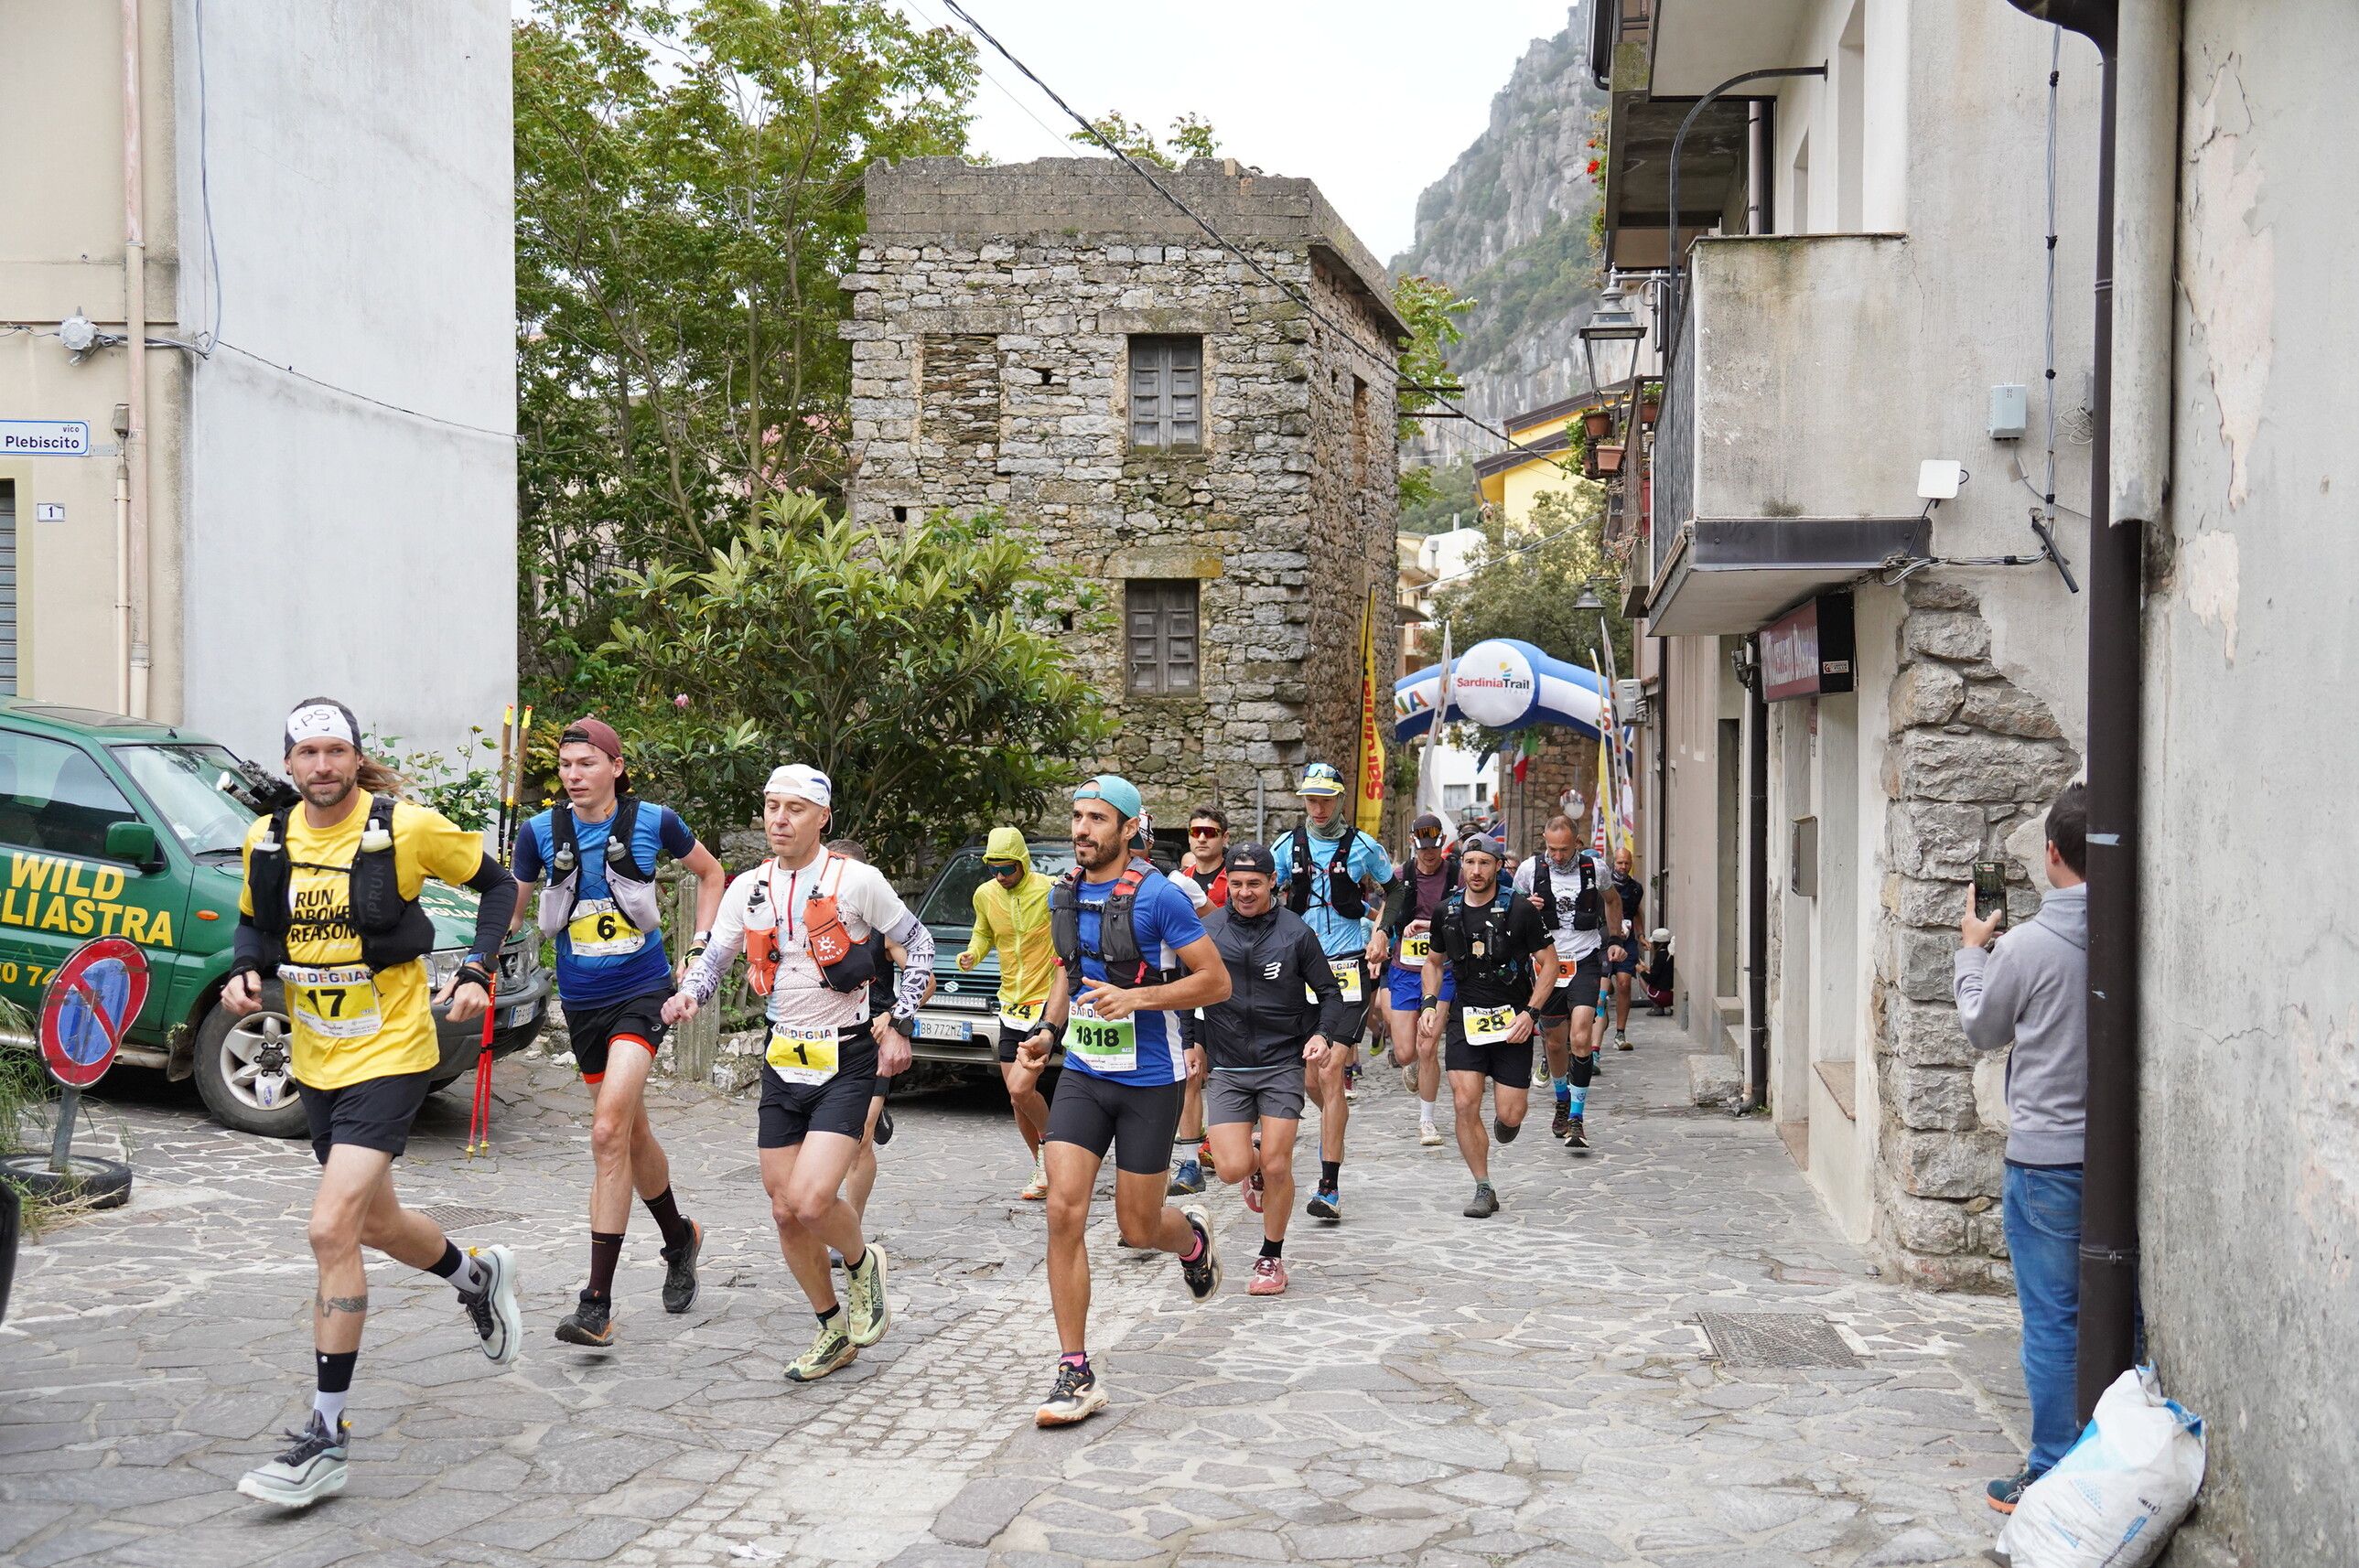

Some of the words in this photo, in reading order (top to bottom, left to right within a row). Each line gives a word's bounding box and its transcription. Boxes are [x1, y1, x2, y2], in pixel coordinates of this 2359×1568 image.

[62, 424, 80, 433] vico
[5, 435, 80, 448] Plebiscito
[48, 506, 53, 518] 1
[1457, 677, 1530, 690] SardiniaTrail
[11, 852, 124, 901] WILD
[295, 888, 334, 908] RUN
[367, 864, 385, 924] IPRUN
[0, 888, 174, 947] LIASTRA
[290, 923, 358, 942] REASON
[597, 915, 617, 941] 6
[278, 970, 366, 984] SARDEGNA
[307, 988, 347, 1017] 17
[1007, 1003, 1031, 1019] 24
[775, 1024, 833, 1040] SARDEGNA
[1476, 1015, 1506, 1032] 28
[1076, 1026, 1120, 1047] 1818
[792, 1043, 809, 1066] 1
